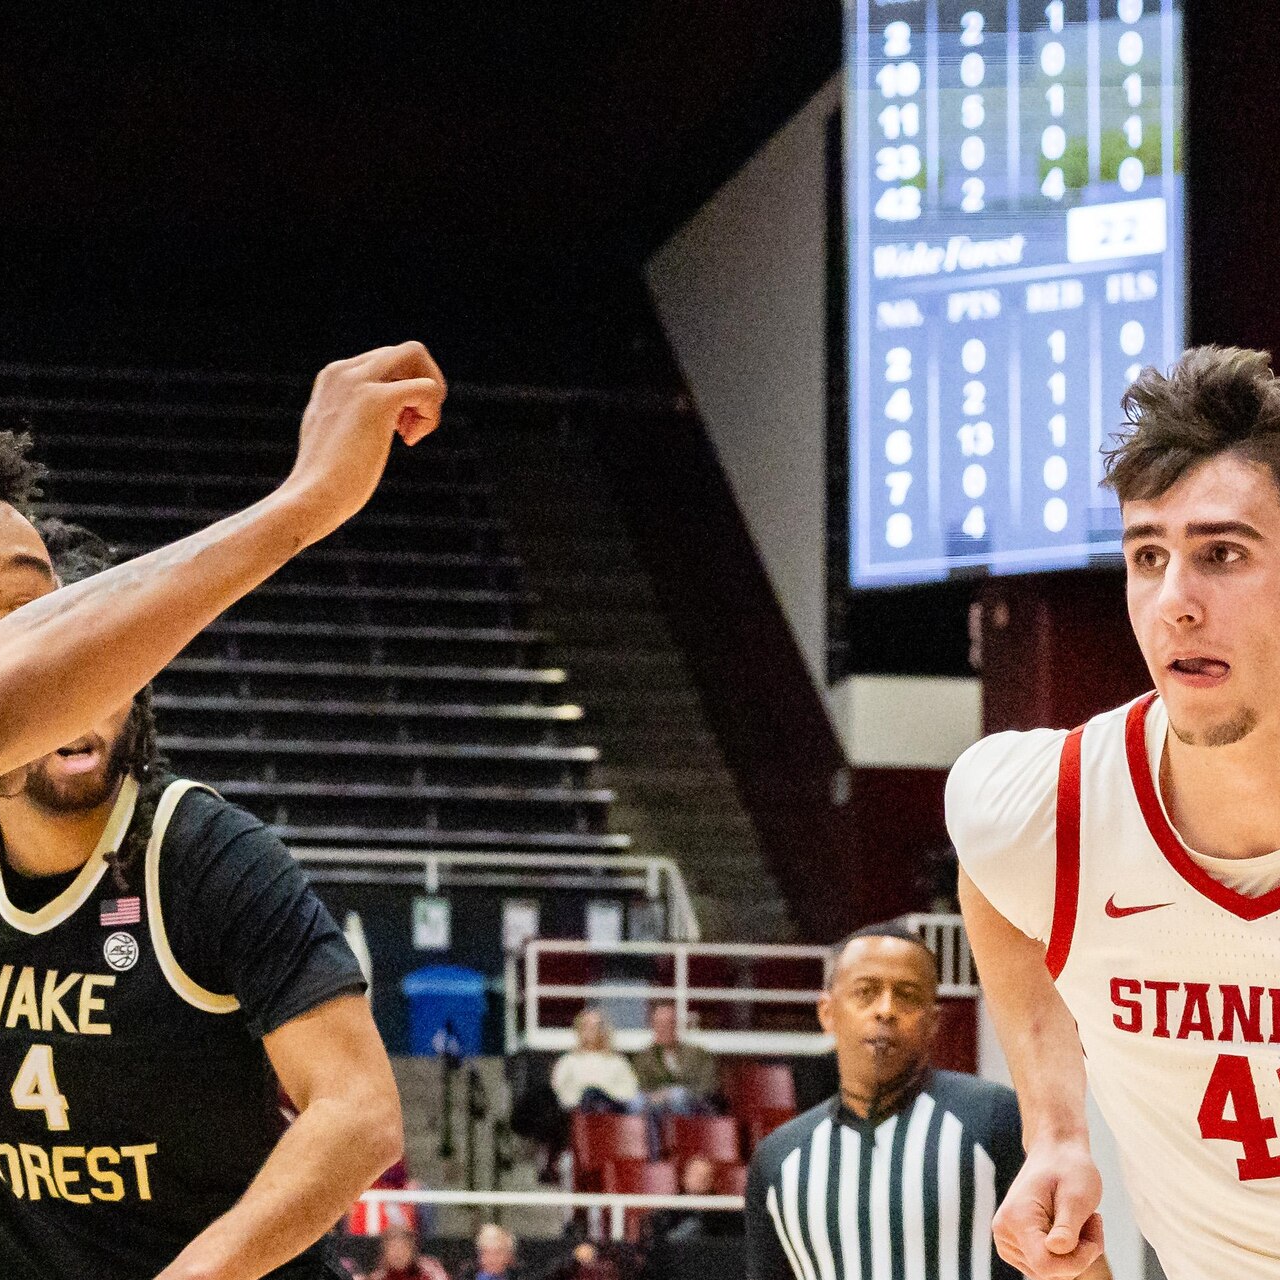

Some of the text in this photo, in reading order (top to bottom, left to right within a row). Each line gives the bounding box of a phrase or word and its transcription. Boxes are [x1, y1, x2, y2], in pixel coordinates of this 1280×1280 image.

[961, 12, 983, 46] 2
[1046, 0, 1065, 32] 1
[878, 31, 1143, 98] 10 0 0 0
[879, 103, 919, 139] 11
[1046, 83, 1065, 116] 1
[1124, 73, 1142, 107] 1
[961, 136, 985, 170] 0
[1042, 125, 1066, 159] 0
[1124, 115, 1142, 148] 1
[962, 177, 985, 212] 2
[1041, 167, 1065, 200] 4
[1119, 158, 1143, 191] 0
[962, 339, 986, 374] 0
[1047, 329, 1066, 363] 1
[1120, 320, 1145, 356] 0
[884, 388, 913, 422] 4
[962, 380, 986, 416] 2
[1048, 371, 1066, 405] 1
[1048, 413, 1067, 447] 1
[885, 455, 1068, 506] 7 0 0
[962, 505, 986, 538] 4
[1043, 497, 1069, 533] 0
[10, 1043, 70, 1132] 4
